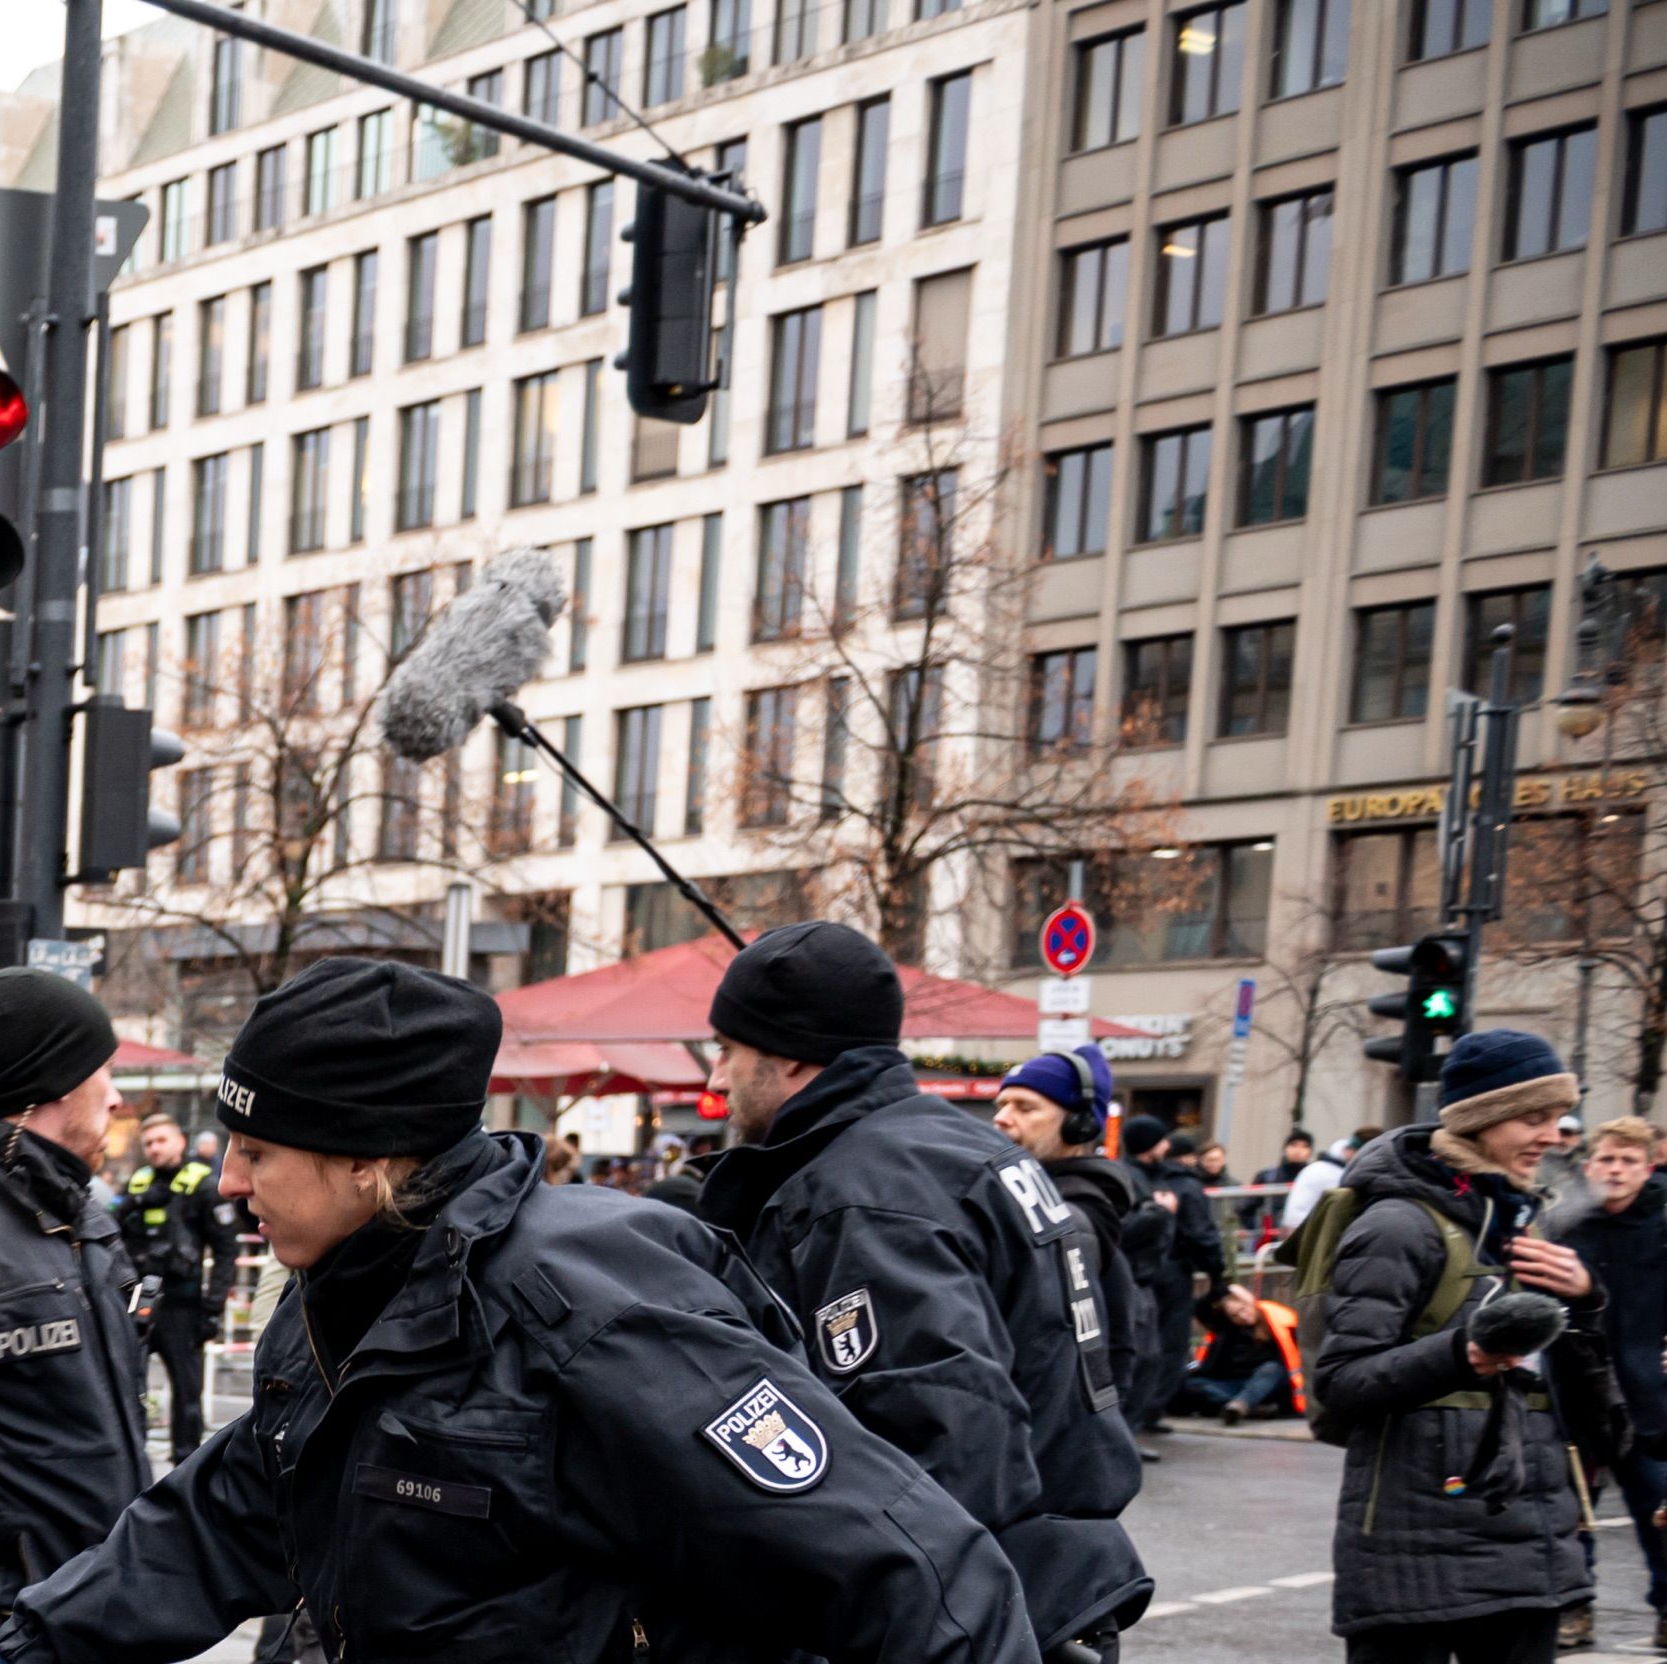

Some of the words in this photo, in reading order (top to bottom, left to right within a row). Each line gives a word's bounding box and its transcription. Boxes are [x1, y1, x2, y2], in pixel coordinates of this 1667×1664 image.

[1098, 1034, 1190, 1060] ONUTS
[218, 1073, 256, 1117] LIZEI
[717, 1387, 779, 1443] POLIZEI
[396, 1479, 441, 1503] 69106
